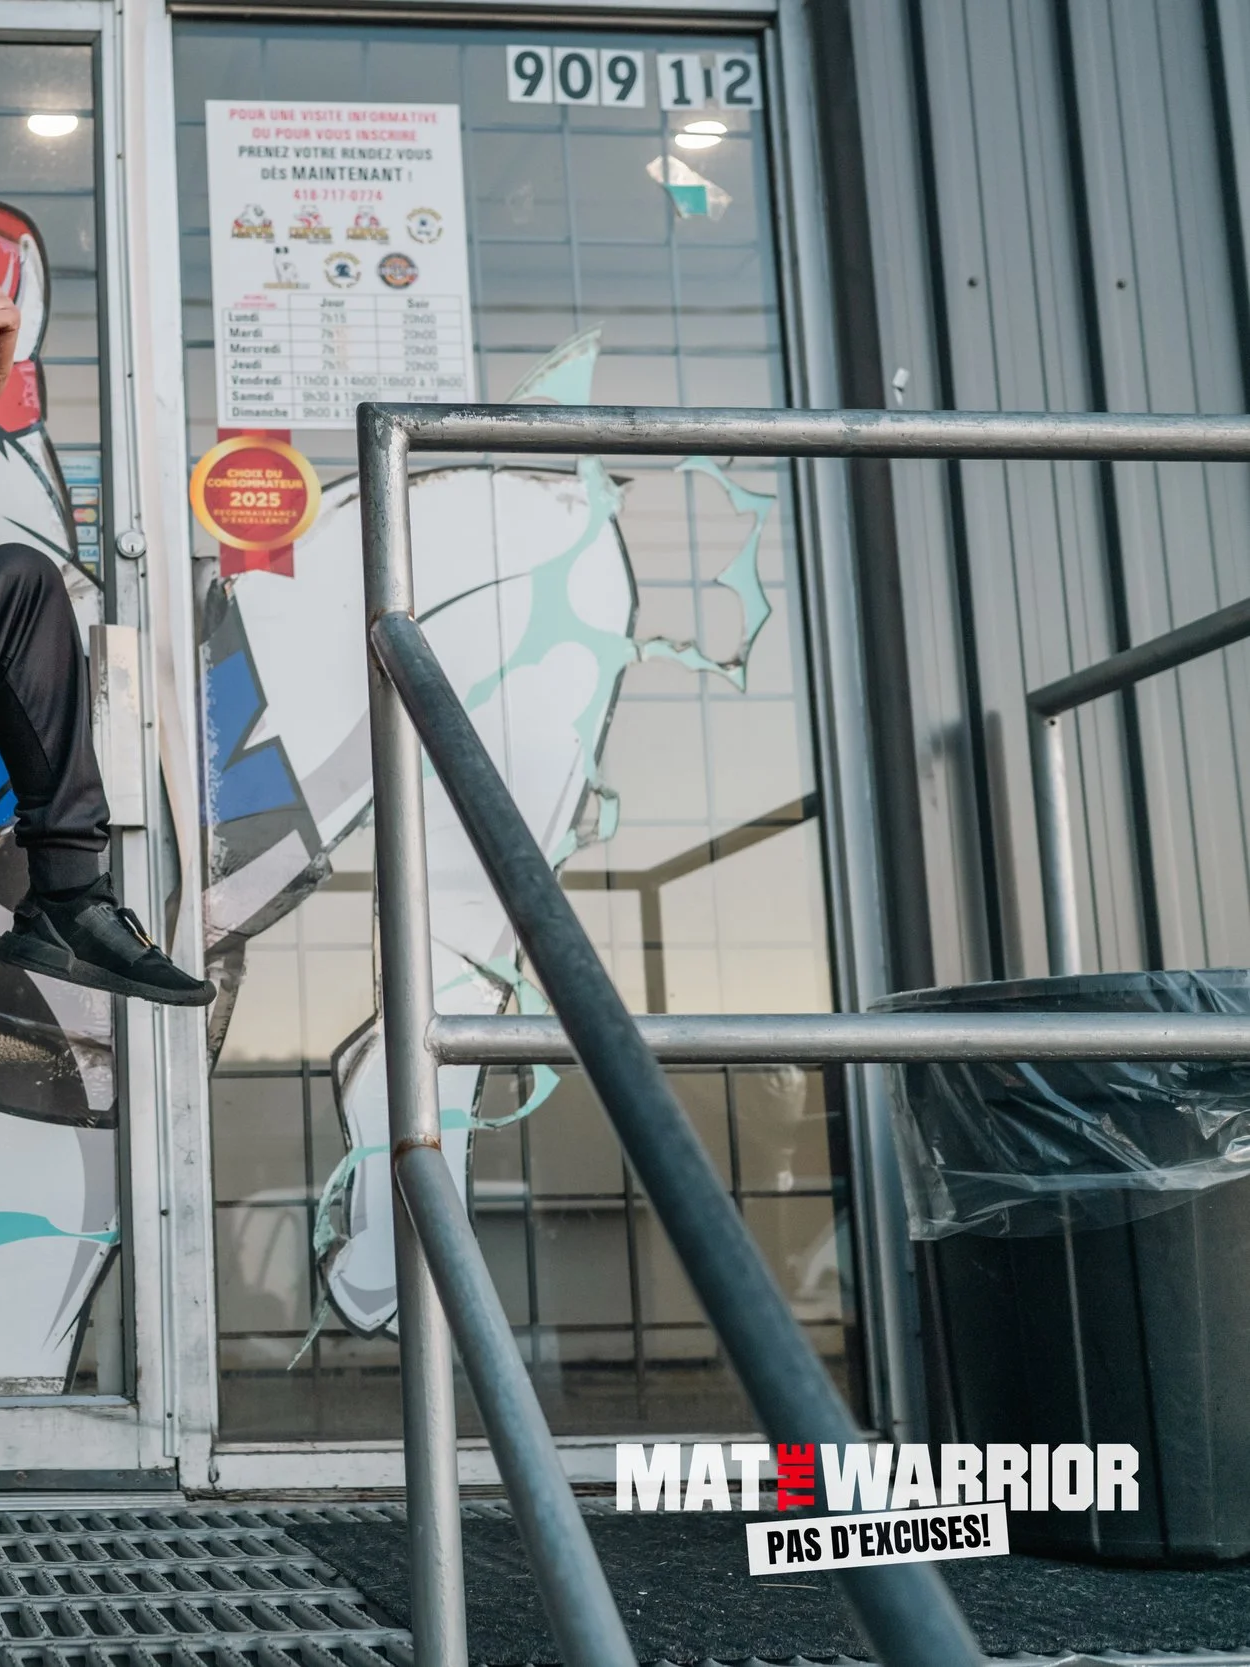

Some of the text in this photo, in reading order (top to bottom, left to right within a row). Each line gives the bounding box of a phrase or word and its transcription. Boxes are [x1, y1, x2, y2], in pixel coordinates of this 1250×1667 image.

[514, 50, 638, 101] 909
[229, 108, 437, 123] POUR UNE VISITE INFORMATIVE
[252, 127, 417, 141] OU POUR VOUS INSCRIRE
[238, 145, 288, 157] PRENEZ
[293, 146, 335, 158] VOTRE
[291, 166, 403, 181] MAINTENANT
[320, 298, 345, 308] Jour
[228, 312, 259, 322] Lundi
[229, 328, 263, 338] Mardi
[230, 344, 281, 354] Mercredi
[231, 359, 262, 369] Jeudi
[232, 375, 282, 385] Vendredi
[232, 391, 274, 401] Samedi
[232, 407, 288, 417] Dimanche
[226, 468, 283, 478] CHOIX DU
[206, 478, 303, 489] CONSOMMATEUR
[230, 491, 281, 508] 2025
